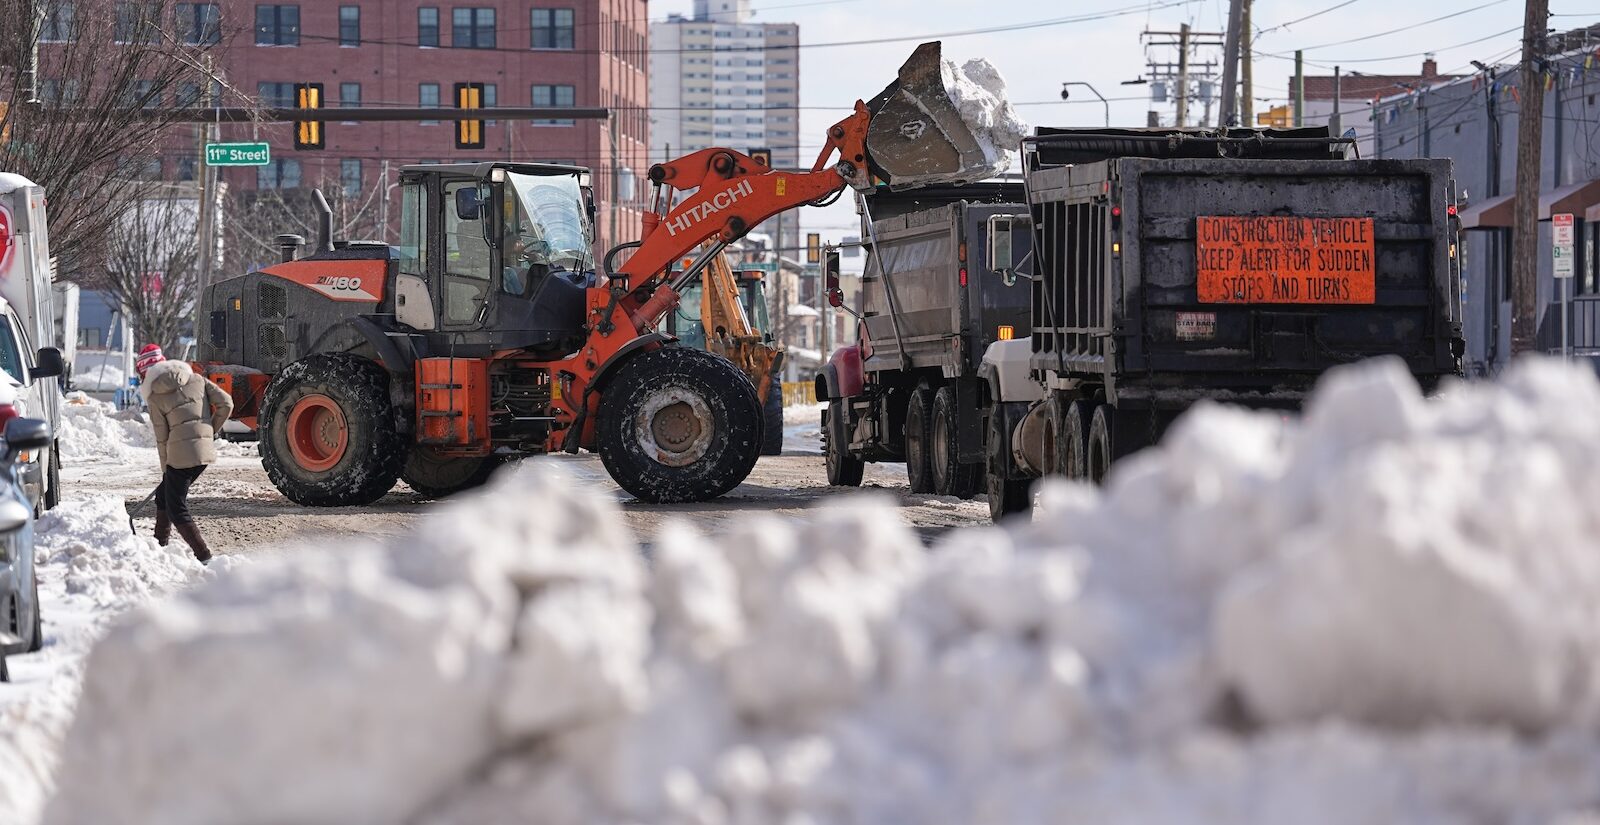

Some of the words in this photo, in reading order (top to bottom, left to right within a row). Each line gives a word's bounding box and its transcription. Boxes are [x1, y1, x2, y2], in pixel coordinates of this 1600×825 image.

[209, 148, 227, 160] 11th
[230, 149, 266, 160] Street
[665, 179, 753, 237] HITACHI
[1203, 219, 1304, 243] CONSTRUCTION
[1311, 220, 1367, 243] VEHICLE
[1201, 248, 1234, 271] KEEP
[1240, 248, 1279, 271] ALERT
[1286, 248, 1311, 271] FOR
[1318, 249, 1370, 272] SUDDEN
[1222, 277, 1264, 300] STOPS
[1272, 277, 1298, 300] AND
[1306, 277, 1350, 300] TURNS
